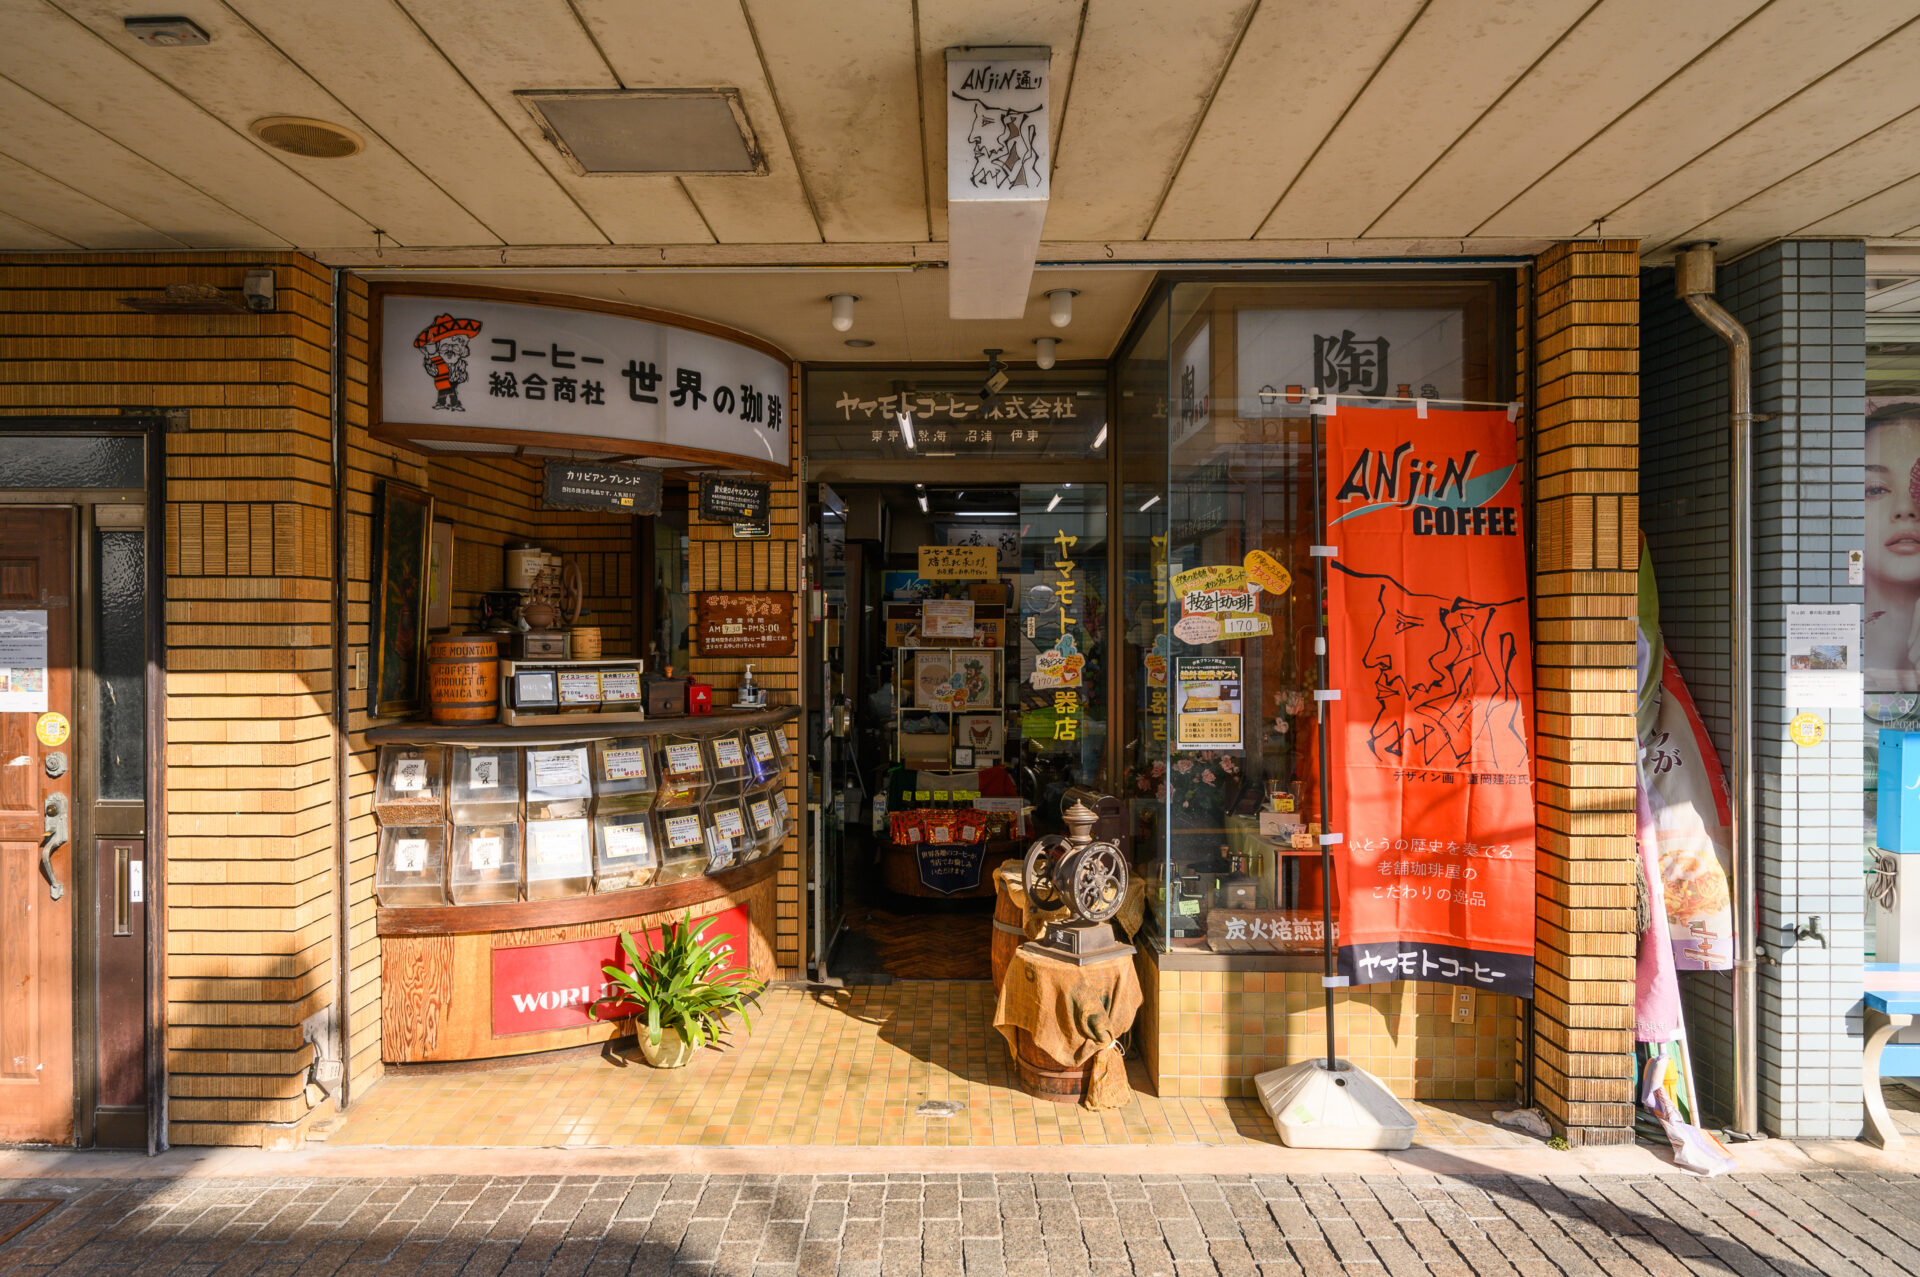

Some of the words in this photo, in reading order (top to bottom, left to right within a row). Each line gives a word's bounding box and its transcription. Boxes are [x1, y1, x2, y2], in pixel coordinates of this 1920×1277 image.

[491, 338, 604, 369] コーヒー
[489, 372, 605, 405] 総合商社
[621, 359, 782, 432] 世界の珈琲
[918, 429, 947, 442] 熱海
[964, 429, 992, 442] 沼津
[1010, 429, 1039, 442] 伊東
[1413, 506, 1517, 536] COFFEE
[1186, 592, 1253, 611] 按針珈琲
[709, 625, 721, 633] AM
[1054, 529, 1079, 741] ヤマモト器店
[449, 645, 493, 656] MOUNTAIN
[439, 665, 478, 675] COFFEE
[435, 677, 473, 687] PRODUCT
[476, 676, 488, 685] OF
[437, 688, 472, 698] JAMAICA
[1393, 771, 1455, 784] デザイン画
[1349, 838, 1513, 859] いとうの歴史を奏でる
[1377, 861, 1477, 881] 老舗珈琲屋の
[1372, 885, 1486, 907] こだわりの逸品
[1359, 950, 1506, 983] ヤマモトコーヒー
